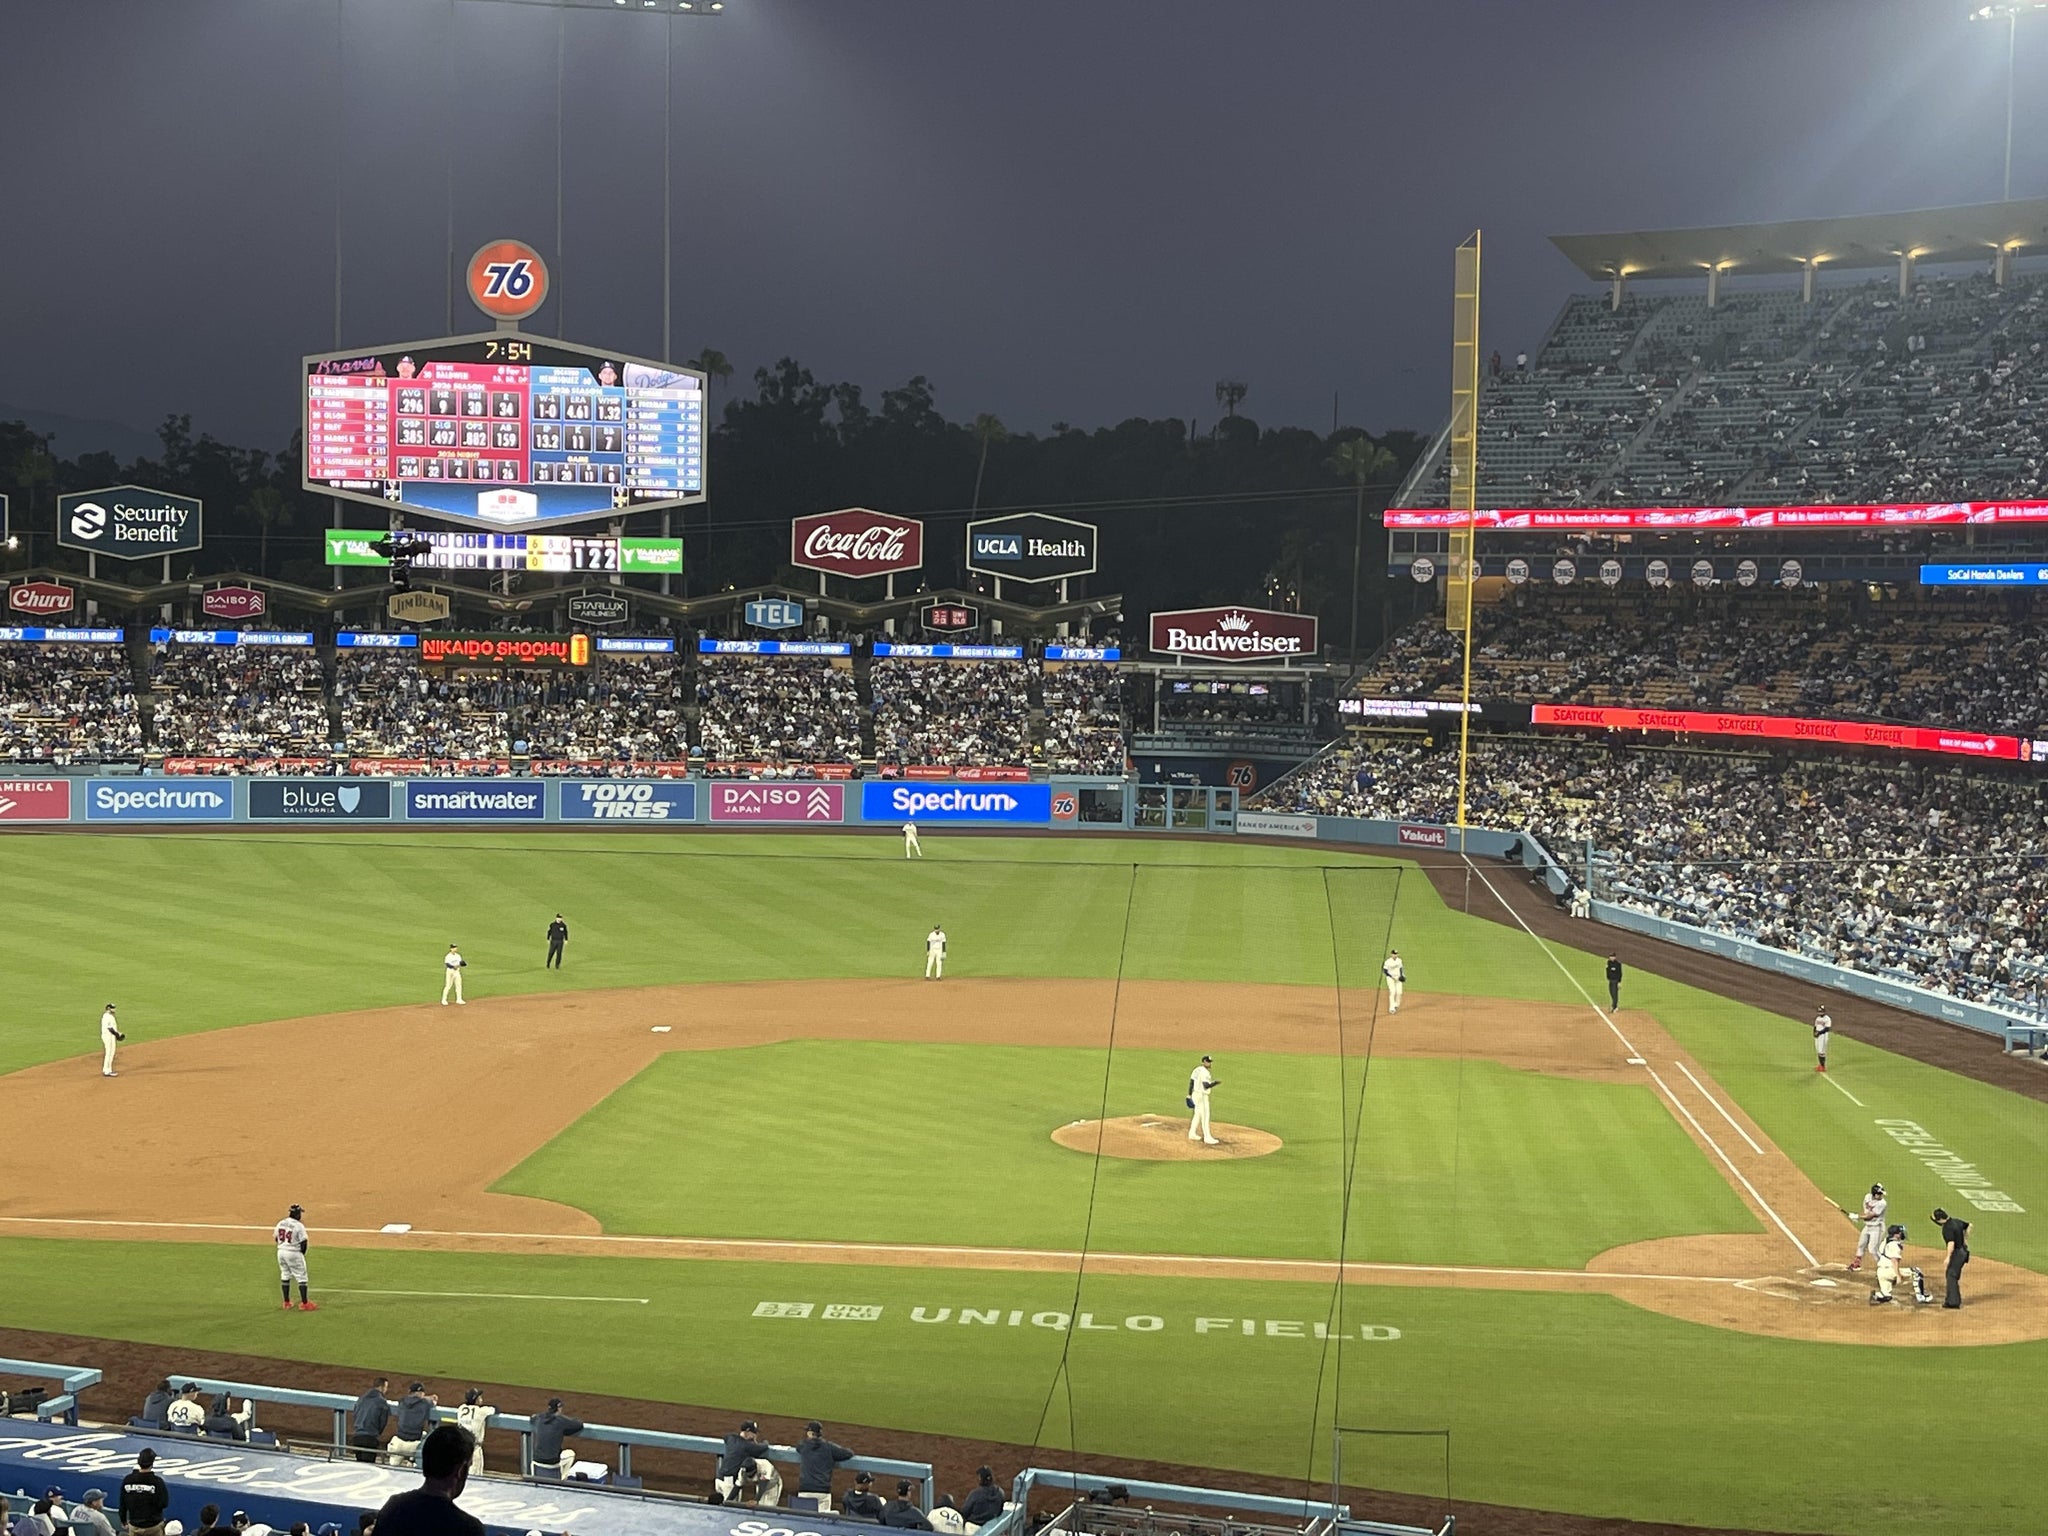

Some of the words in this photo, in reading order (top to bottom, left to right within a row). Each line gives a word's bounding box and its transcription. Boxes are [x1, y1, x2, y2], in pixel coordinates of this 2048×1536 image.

[483, 260, 532, 297] 76
[486, 342, 531, 360] 7:54
[399, 399, 423, 413] .296
[439, 400, 448, 414] 9
[468, 401, 482, 415] 30
[499, 402, 514, 416] 34
[539, 404, 557, 418] 1-0
[566, 405, 589, 419] 4.61
[599, 406, 620, 420] 1.32
[399, 430, 423, 443] .385
[431, 431, 455, 444] .497
[463, 432, 486, 446] .882
[497, 433, 516, 447] 159
[536, 434, 558, 448] 13.2
[572, 435, 584, 449] 11
[605, 436, 613, 450] 7
[399, 465, 418, 476] .264
[455, 467, 462, 478] 4
[478, 468, 489, 478] 19
[502, 468, 514, 479] 26
[538, 469, 548, 480] 31
[561, 470, 572, 481] 20
[584, 471, 593, 481] 11
[608, 472, 615, 483] 0
[113, 504, 188, 527] Security
[114, 524, 178, 542] Benefit
[804, 524, 910, 561] Coca-Cola
[977, 538, 1018, 555] UCLA
[1028, 539, 1086, 557] Health
[574, 547, 583, 568] 1
[588, 548, 601, 569] 2
[604, 548, 616, 569] 2
[1947, 568, 1970, 580] SoCal
[12, 589, 71, 609] Churu
[206, 595, 247, 605] DAISO
[393, 596, 414, 615] JIM
[415, 594, 444, 615] BEAM
[572, 601, 624, 611] STARLUX
[580, 610, 617, 618] AIRLINES
[752, 604, 796, 625] TEL
[422, 639, 494, 656] NIKAIDO
[496, 641, 567, 657] SHOCHU
[1637, 712, 1687, 728] SEATGEEK
[1718, 717, 1764, 733] SEATGEEK
[1864, 727, 1904, 743] SEATGEEK
[1231, 766, 1253, 786] 76
[282, 786, 335, 807] blue
[580, 784, 653, 801] TOYO
[724, 789, 801, 804] DAISO
[97, 786, 215, 814] Spectrum
[414, 791, 537, 811] smartwater
[892, 787, 1010, 815] Spectrum
[1053, 798, 1075, 813] 76
[591, 801, 671, 819] TIRES
[1238, 821, 1258, 829] BANK
[1269, 823, 1300, 831] AMERICA
[1401, 828, 1444, 844] Yakult
[910, 1306, 1165, 1333] UNIQLO
[1195, 1316, 1401, 1342] FIELD
[172, 1406, 188, 1420] 68
[461, 1407, 475, 1419] 21
[939, 1511, 960, 1523] 94
